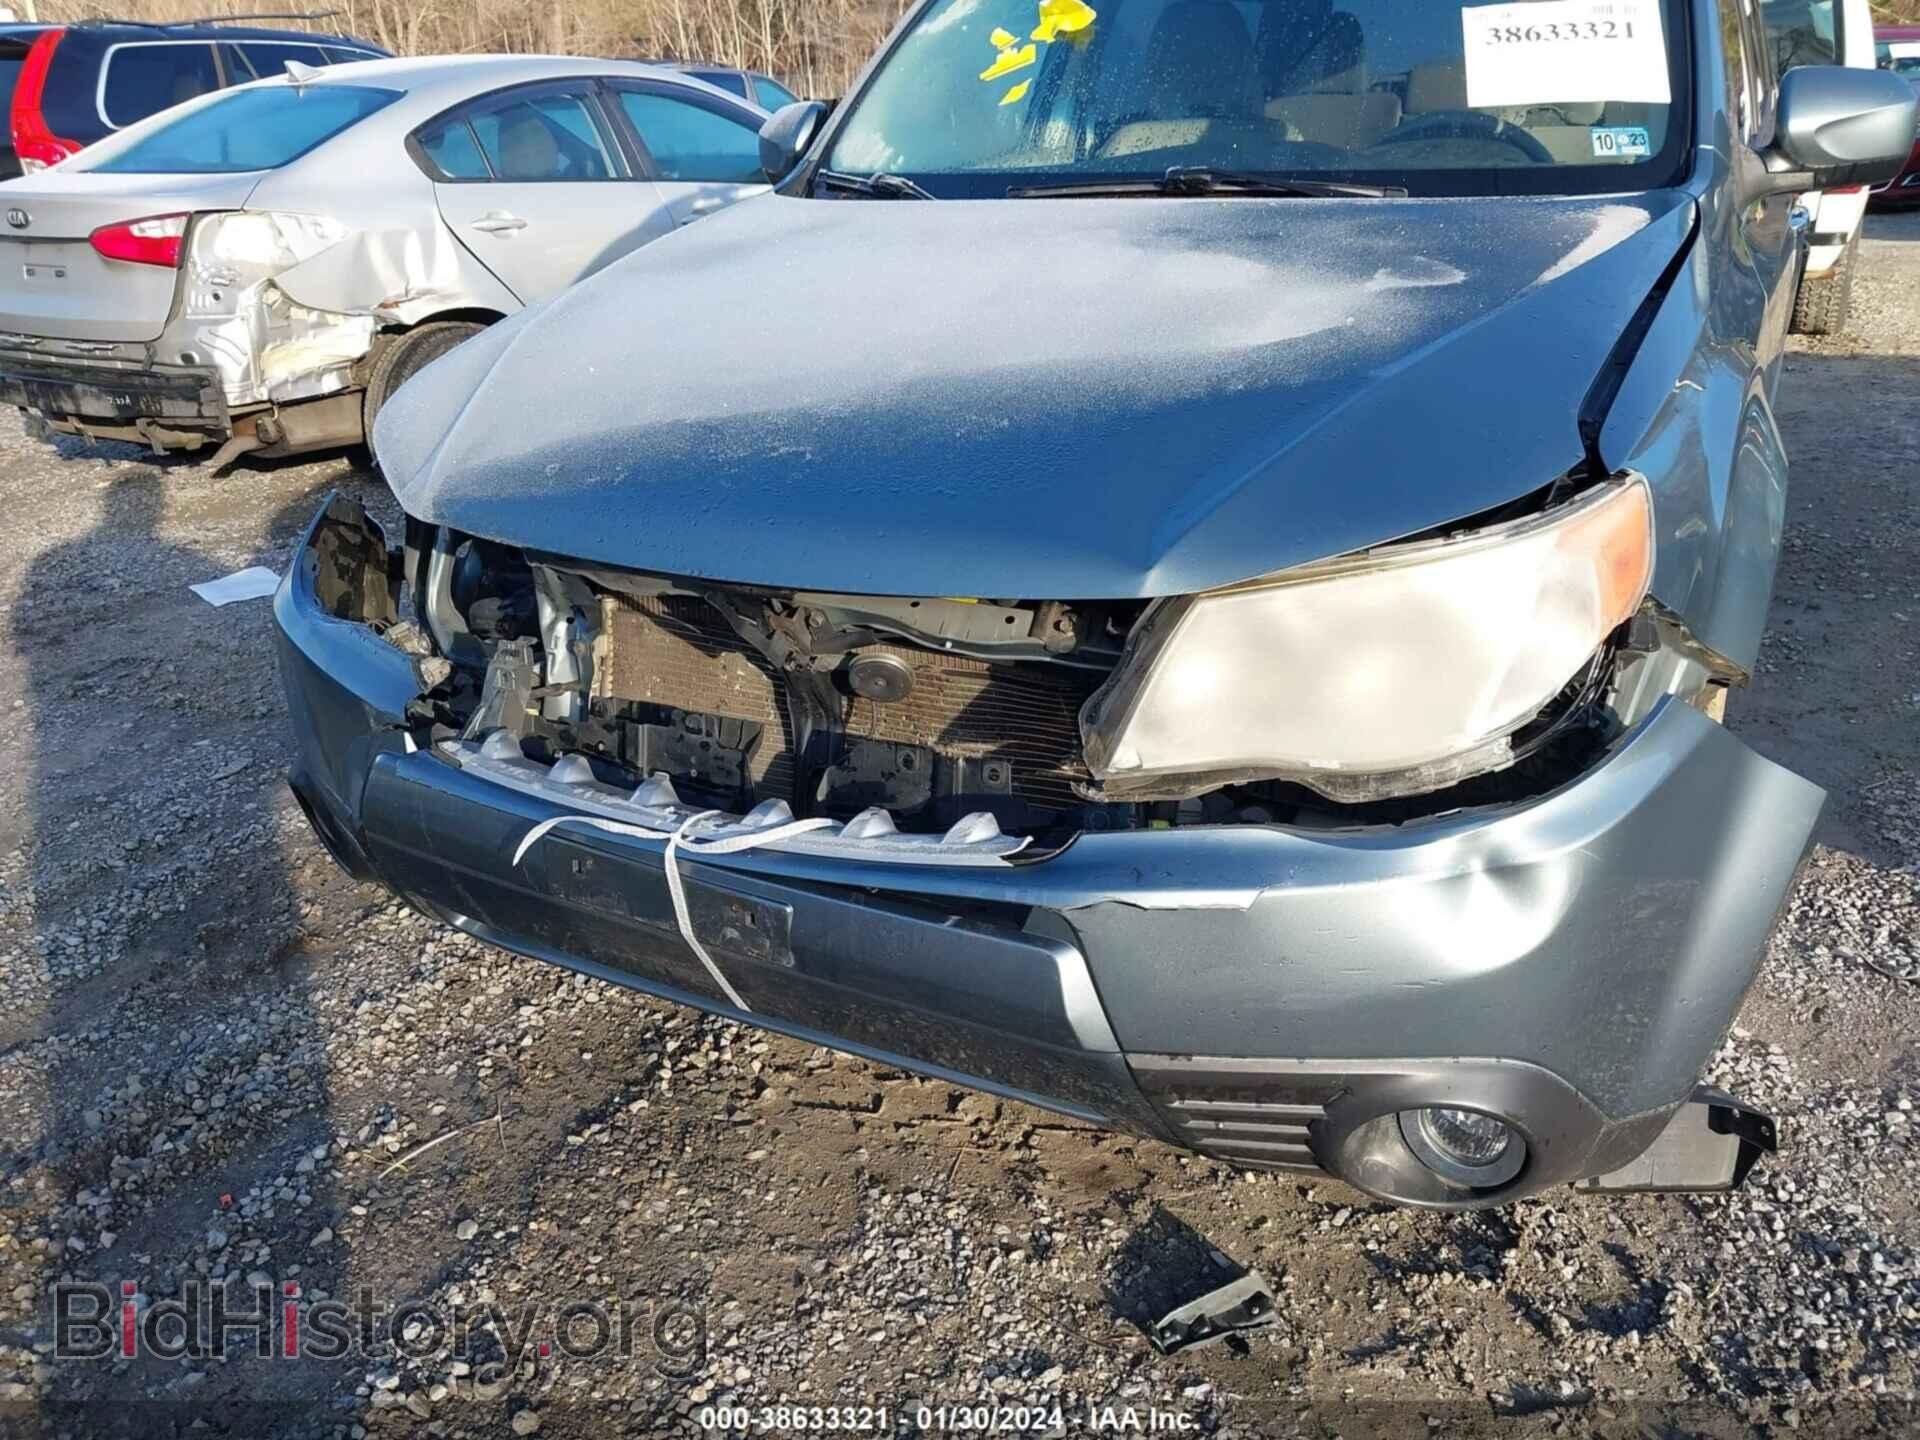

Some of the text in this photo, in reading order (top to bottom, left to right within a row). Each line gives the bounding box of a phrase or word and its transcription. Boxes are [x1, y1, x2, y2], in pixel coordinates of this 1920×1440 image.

[1487, 21, 1635, 45] 38633321
[1594, 133, 1647, 151] 10 23
